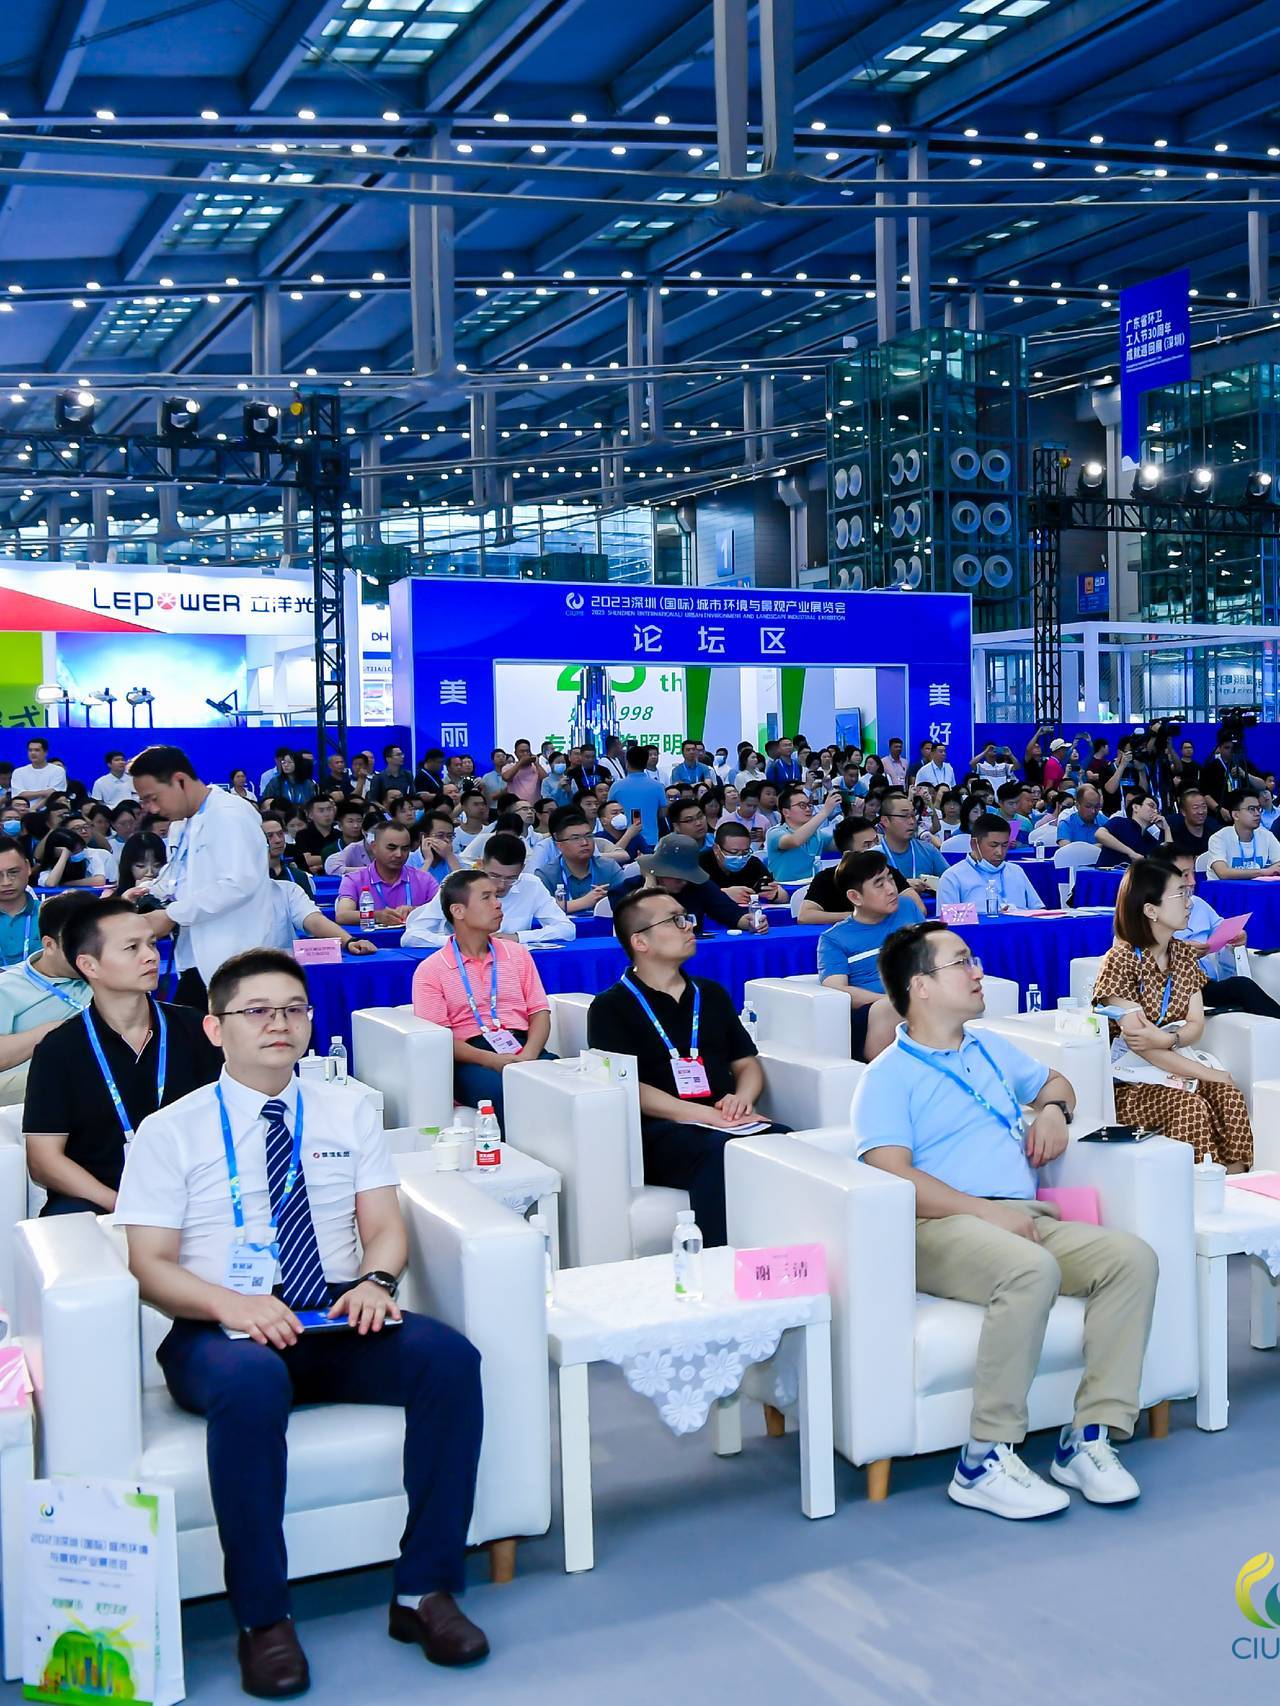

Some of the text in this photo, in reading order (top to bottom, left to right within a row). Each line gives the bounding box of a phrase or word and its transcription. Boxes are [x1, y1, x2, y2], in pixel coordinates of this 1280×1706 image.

[1126, 309, 1162, 332] 广东省环卫
[1126, 322, 1172, 347] 工人节30周年
[94, 588, 240, 616] LEPOWER
[591, 595, 846, 614] 2023深圳(国际)城市环境与景观产业展览会
[633, 625, 786, 653] 论坛区
